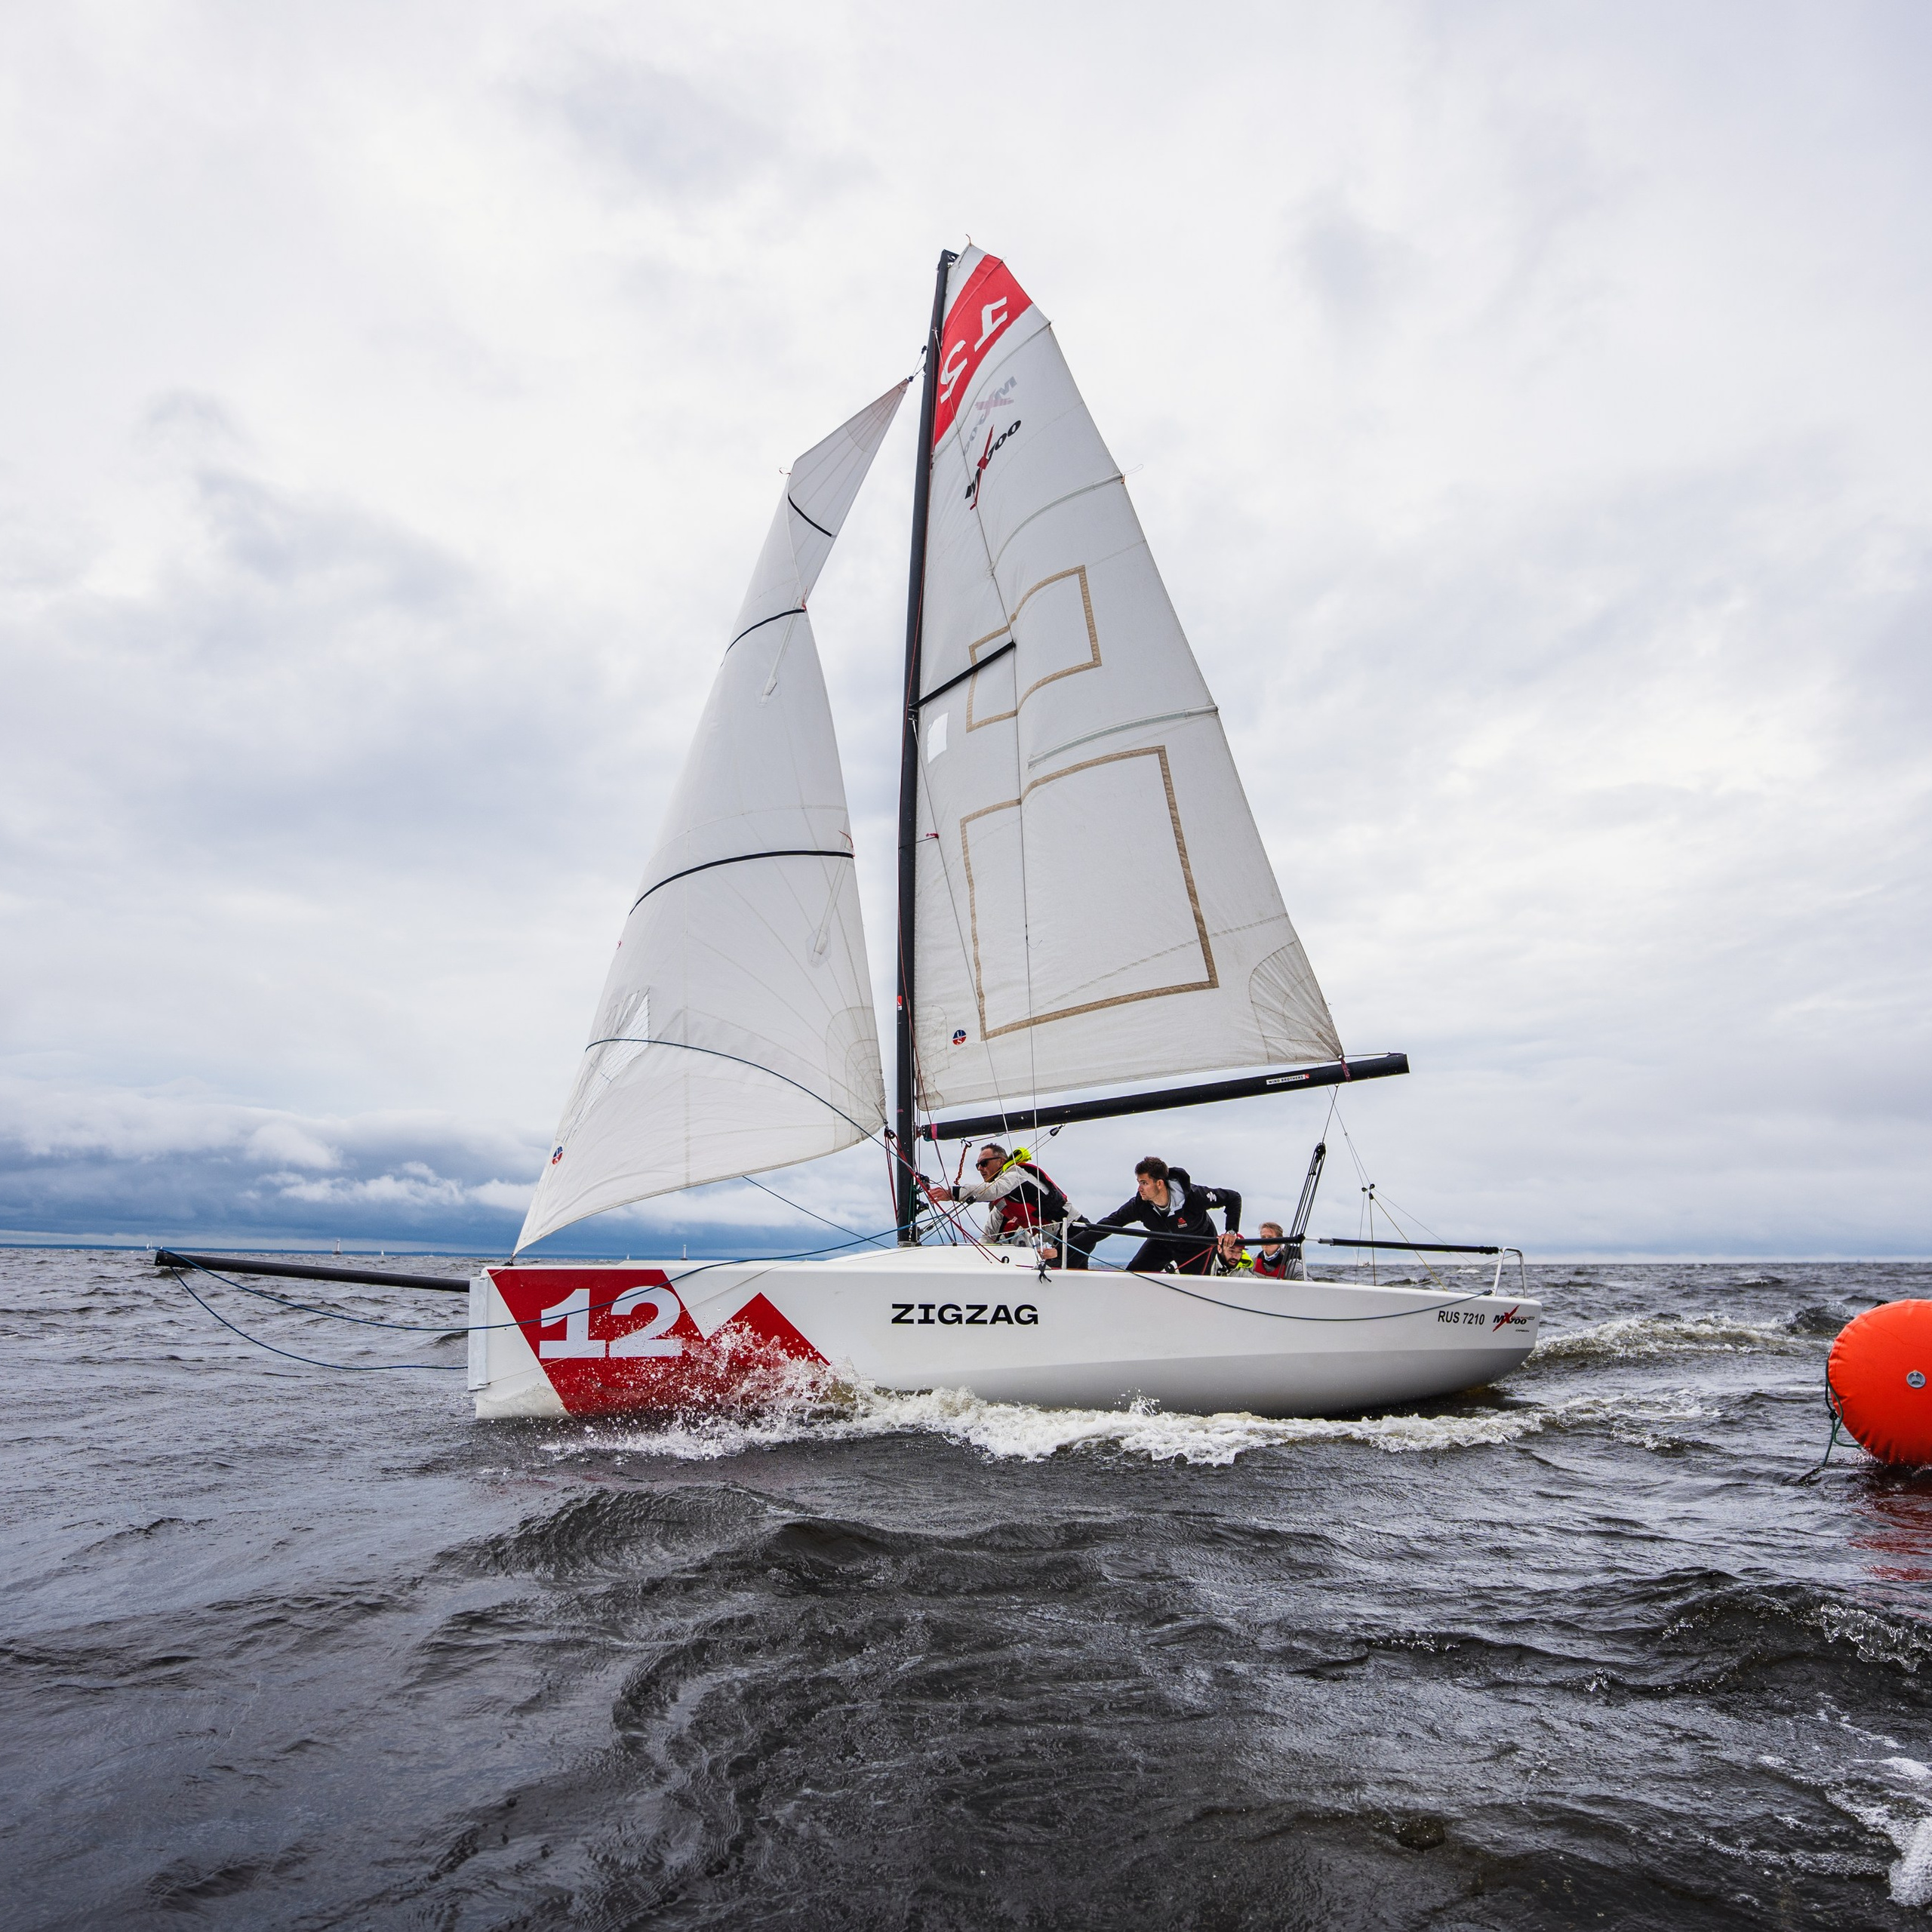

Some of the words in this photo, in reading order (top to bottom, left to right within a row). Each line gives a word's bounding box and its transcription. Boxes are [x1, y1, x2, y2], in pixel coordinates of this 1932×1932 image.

[539, 1285, 682, 1358] 12
[891, 1303, 1038, 1324] ZIGZAG
[1438, 1310, 1460, 1324] RUS
[1463, 1312, 1485, 1325] 7210
[1492, 1304, 1527, 1333] MX700
